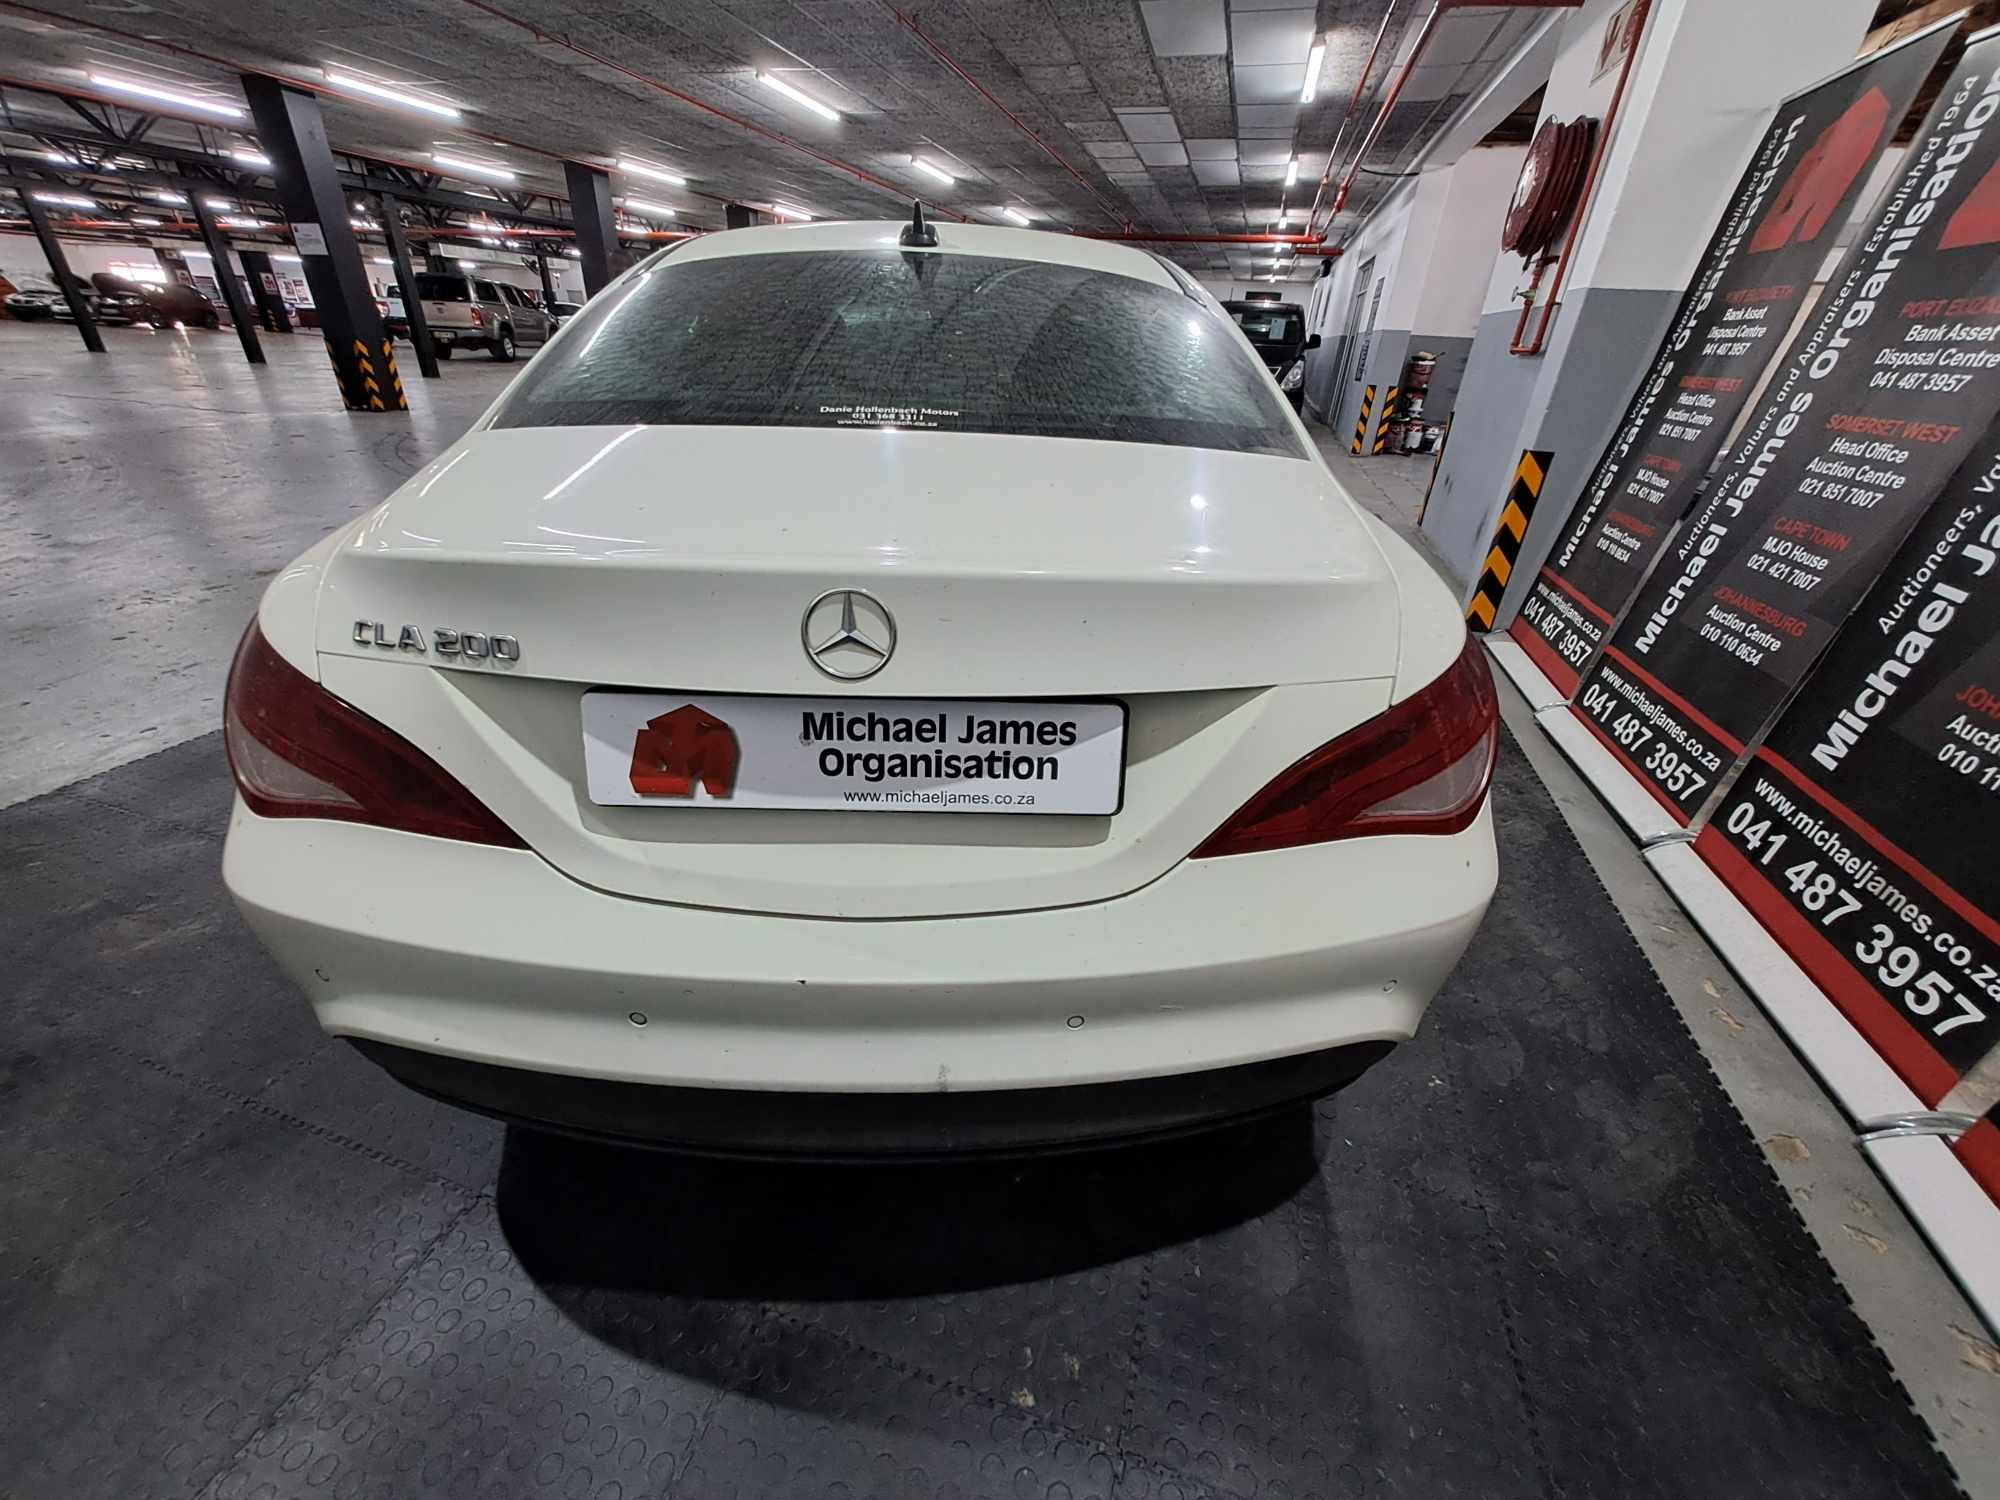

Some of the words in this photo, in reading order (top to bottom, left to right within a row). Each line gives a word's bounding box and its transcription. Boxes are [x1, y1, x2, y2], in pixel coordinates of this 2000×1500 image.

[1630, 373, 1658, 419] Valuers
[1657, 343, 1672, 370] and
[1714, 171, 1762, 257] Established
[1677, 471, 1740, 560] Auctioneers,
[1735, 406, 1778, 465] Valuers
[1776, 367, 1801, 402] and
[1798, 269, 1862, 366] Appraisers
[1864, 137, 1942, 252] Established
[1937, 74, 1980, 130] 1964
[1904, 325, 1949, 342] Bank
[1943, 323, 2000, 342] Asset
[1558, 463, 1620, 568] Michael
[1620, 360, 1675, 458] James
[1673, 114, 1808, 352] Organisation
[1874, 348, 1937, 368] Disposal
[1939, 348, 2000, 367] Centre
[1869, 371, 1896, 388] 041
[1898, 372, 1928, 389] 487
[1923, 373, 1973, 392] 3957
[856, 406, 918, 414] Hollenbach
[921, 408, 959, 417] Motors
[1829, 437, 1864, 457] Head
[1865, 442, 1909, 464] Office
[1902, 422, 1961, 444] WEST
[1799, 477, 1822, 496] 021
[1822, 483, 1846, 501] 851
[1845, 488, 1884, 509] 7007
[1806, 457, 1857, 481] Auction
[1855, 465, 1906, 489] Centre
[1634, 522, 1728, 655] Michael
[1725, 391, 1814, 518] James
[1775, 516, 1811, 539] CAPE
[1811, 527, 1851, 551] TOWN
[1747, 554, 1770, 572] 021
[1769, 563, 1790, 580] 421
[1787, 568, 1821, 591] 7007
[1762, 536, 1792, 556] MJO
[1790, 546, 1829, 570] House
[1877, 504, 1983, 635] Auctioneers,
[1523, 596, 1546, 624] 041
[1541, 612, 1565, 641] 487
[1559, 629, 1593, 667] 3957
[1706, 605, 1748, 633] Auction
[1745, 623, 1781, 651] Centre
[1714, 587, 1807, 638] JOHANNESBURG
[353, 617, 427, 652] CLA
[433, 626, 520, 662] 200
[1700, 623, 1720, 643] 010
[1719, 633, 1739, 651] 110
[1735, 642, 1763, 666] 0634
[1810, 581, 1970, 773] Michael
[801, 711, 947, 743] Michael
[958, 715, 1077, 746] James
[1600, 666, 1721, 772] www.michaeljames.co.za
[1583, 684, 1617, 722] 041
[1613, 712, 1653, 752] 487
[1646, 743, 1706, 800] 3957
[1938, 743, 1979, 774] 010
[818, 748, 1060, 783] Organisation
[843, 788, 1036, 807] www.michaeljames.co.za
[1754, 777, 2000, 1003] www.michaeljames.co.za
[1727, 802, 1788, 865] 041
[1784, 860, 1863, 926] 487
[1855, 924, 1987, 1037] 3957
